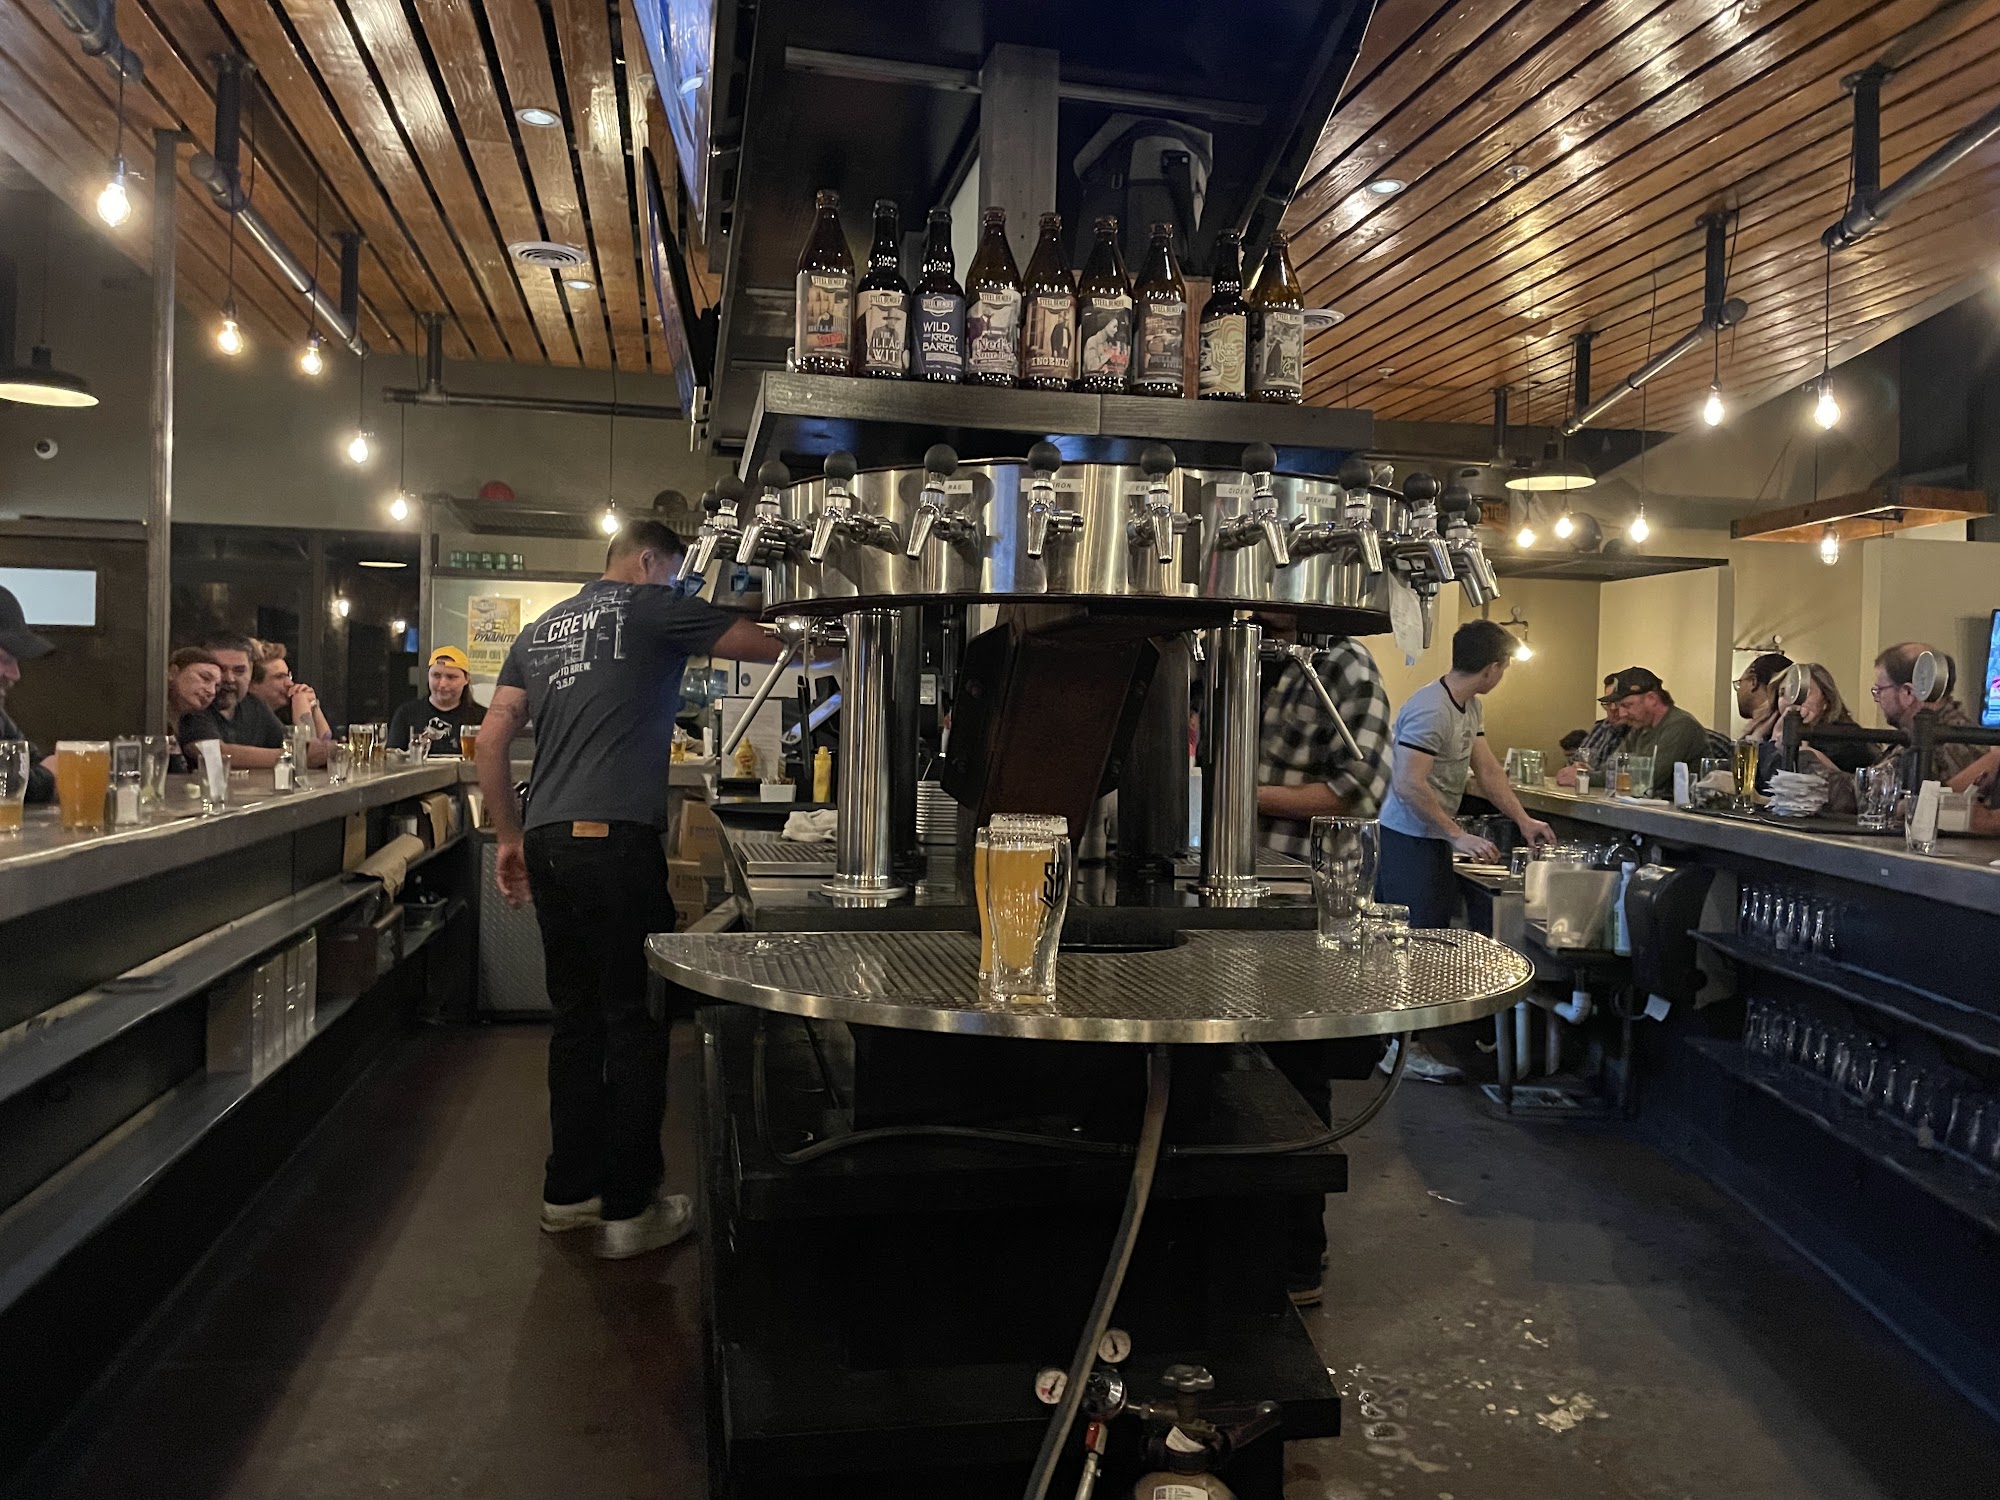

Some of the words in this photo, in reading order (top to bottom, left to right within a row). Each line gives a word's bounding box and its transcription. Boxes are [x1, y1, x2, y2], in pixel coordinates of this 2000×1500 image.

[923, 321, 950, 332] WILD
[922, 342, 959, 354] BARREL
[872, 349, 898, 362] WIT
[548, 609, 600, 643] CREW
